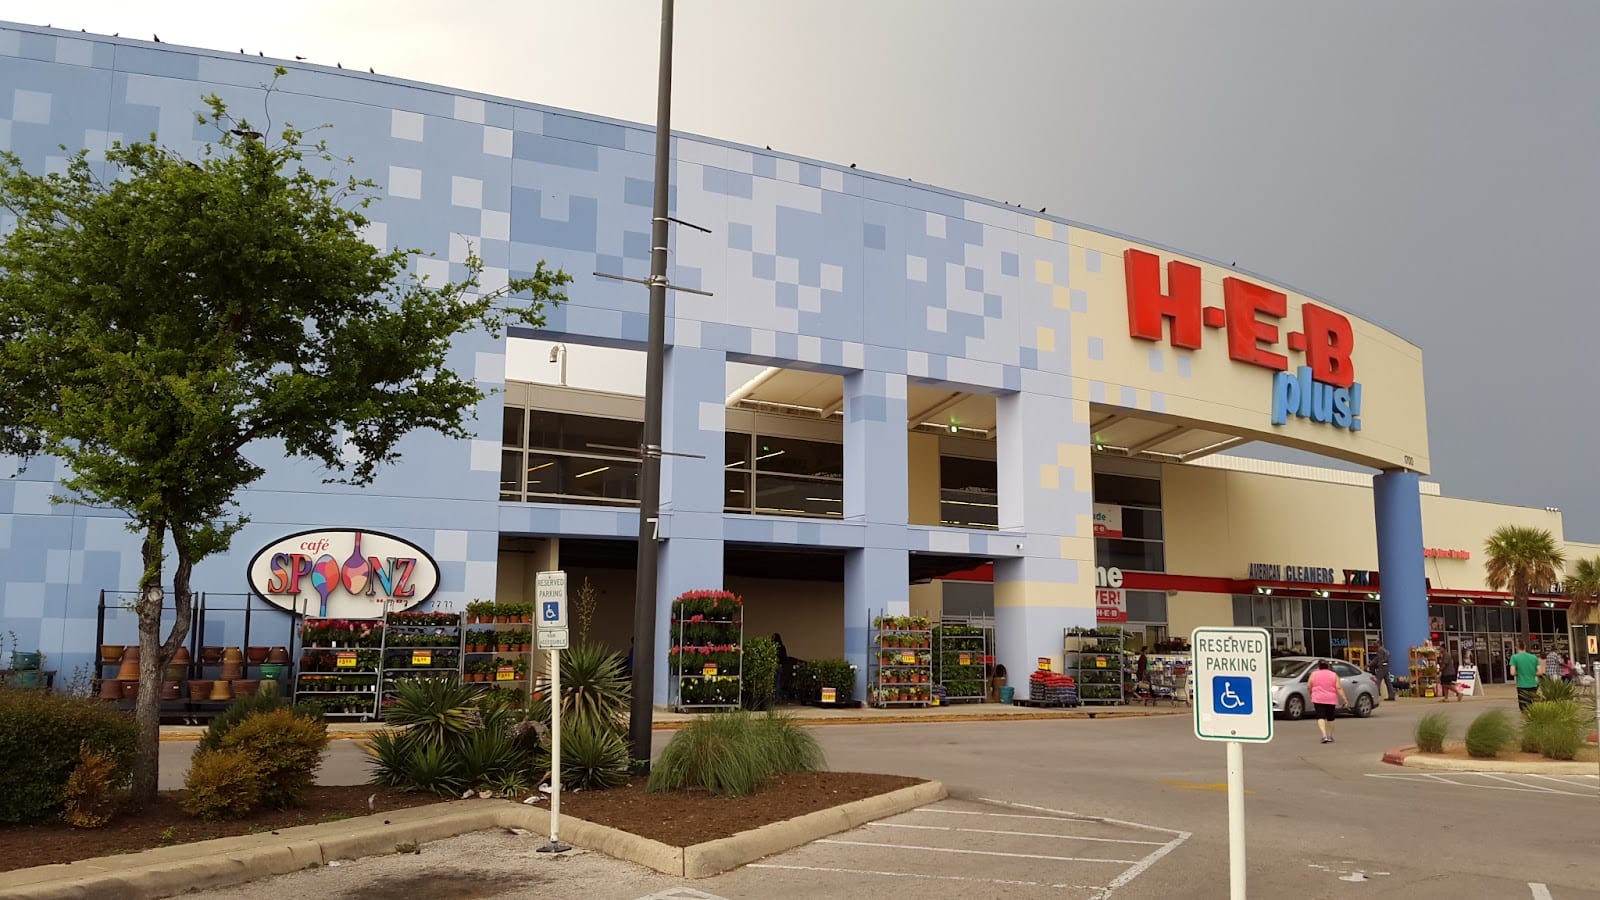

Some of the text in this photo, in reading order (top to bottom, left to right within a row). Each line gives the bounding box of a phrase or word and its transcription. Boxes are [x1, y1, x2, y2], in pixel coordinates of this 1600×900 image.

[1124, 248, 1355, 388] H-E-B
[1271, 366, 1363, 433] plus!
[646, 517, 658, 540] 7
[300, 538, 329, 555] café
[268, 552, 417, 598] SPOONZ
[1249, 563, 1334, 583] AMERICAN CLEANERS
[538, 578, 564, 587] RESERVED
[539, 590, 563, 598] PARKING
[1200, 639, 1263, 654] RESERVED
[1206, 657, 1257, 672] PARKING
